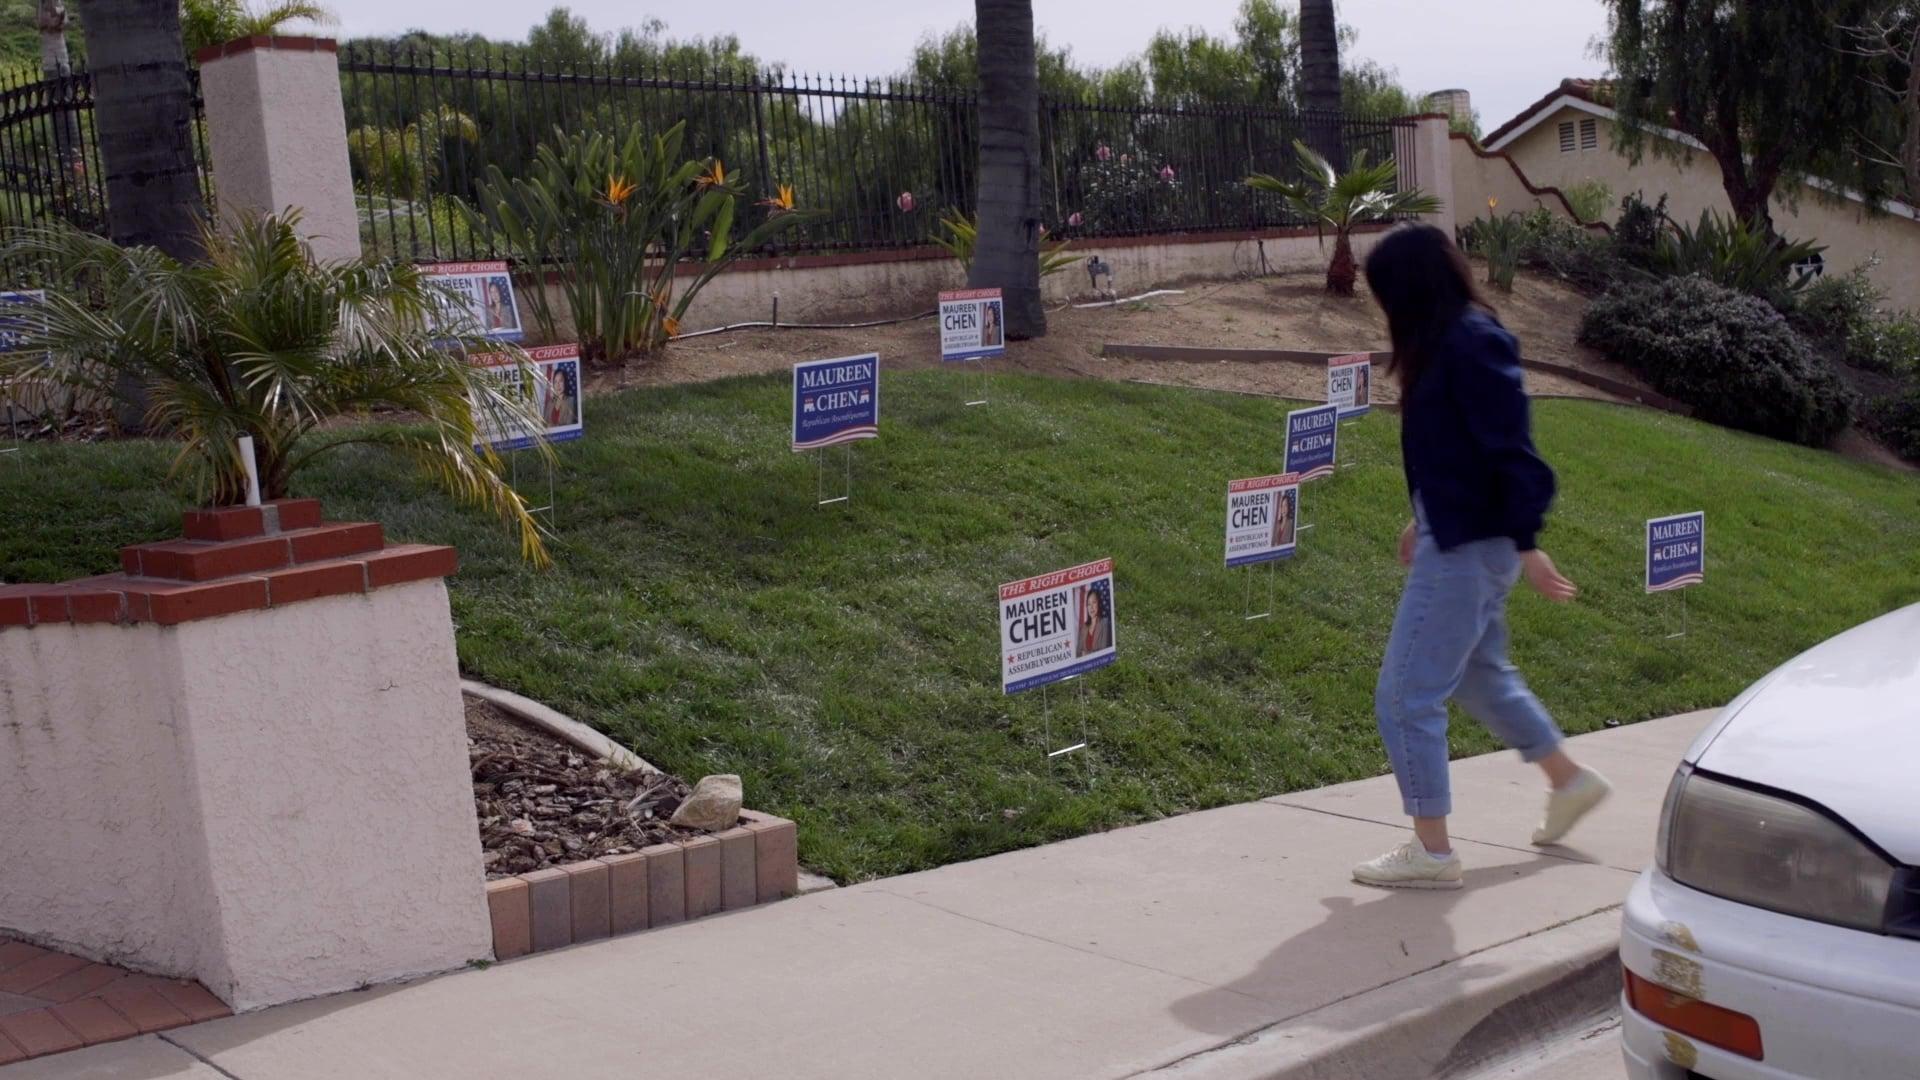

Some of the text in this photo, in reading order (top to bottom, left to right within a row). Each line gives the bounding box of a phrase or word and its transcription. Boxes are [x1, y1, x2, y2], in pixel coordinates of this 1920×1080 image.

[437, 264, 467, 274] RIGHT
[470, 262, 507, 272] CHOICE
[943, 303, 977, 314] MAUREEN
[945, 313, 977, 330] CHEN
[536, 345, 577, 359] CHOICE
[802, 362, 873, 389] MAUREEN
[1331, 377, 1352, 393] CHEN
[816, 389, 859, 412] CHEN
[1292, 410, 1335, 433] MAUREEN
[1300, 433, 1326, 452] CHEN
[1231, 492, 1270, 509] MAUREEN
[1232, 505, 1268, 529] CHEN
[1652, 519, 1700, 541] MAUREEN
[1662, 541, 1691, 560] CHEN
[1001, 560, 1110, 598] THE RIGHT CHOICE
[1005, 590, 1068, 620] MAUREEN
[1009, 607, 1067, 644] CHEN
[1017, 641, 1063, 662] REPUBLICAN
[1008, 650, 1072, 676] ASSEMBLYWOMAN
